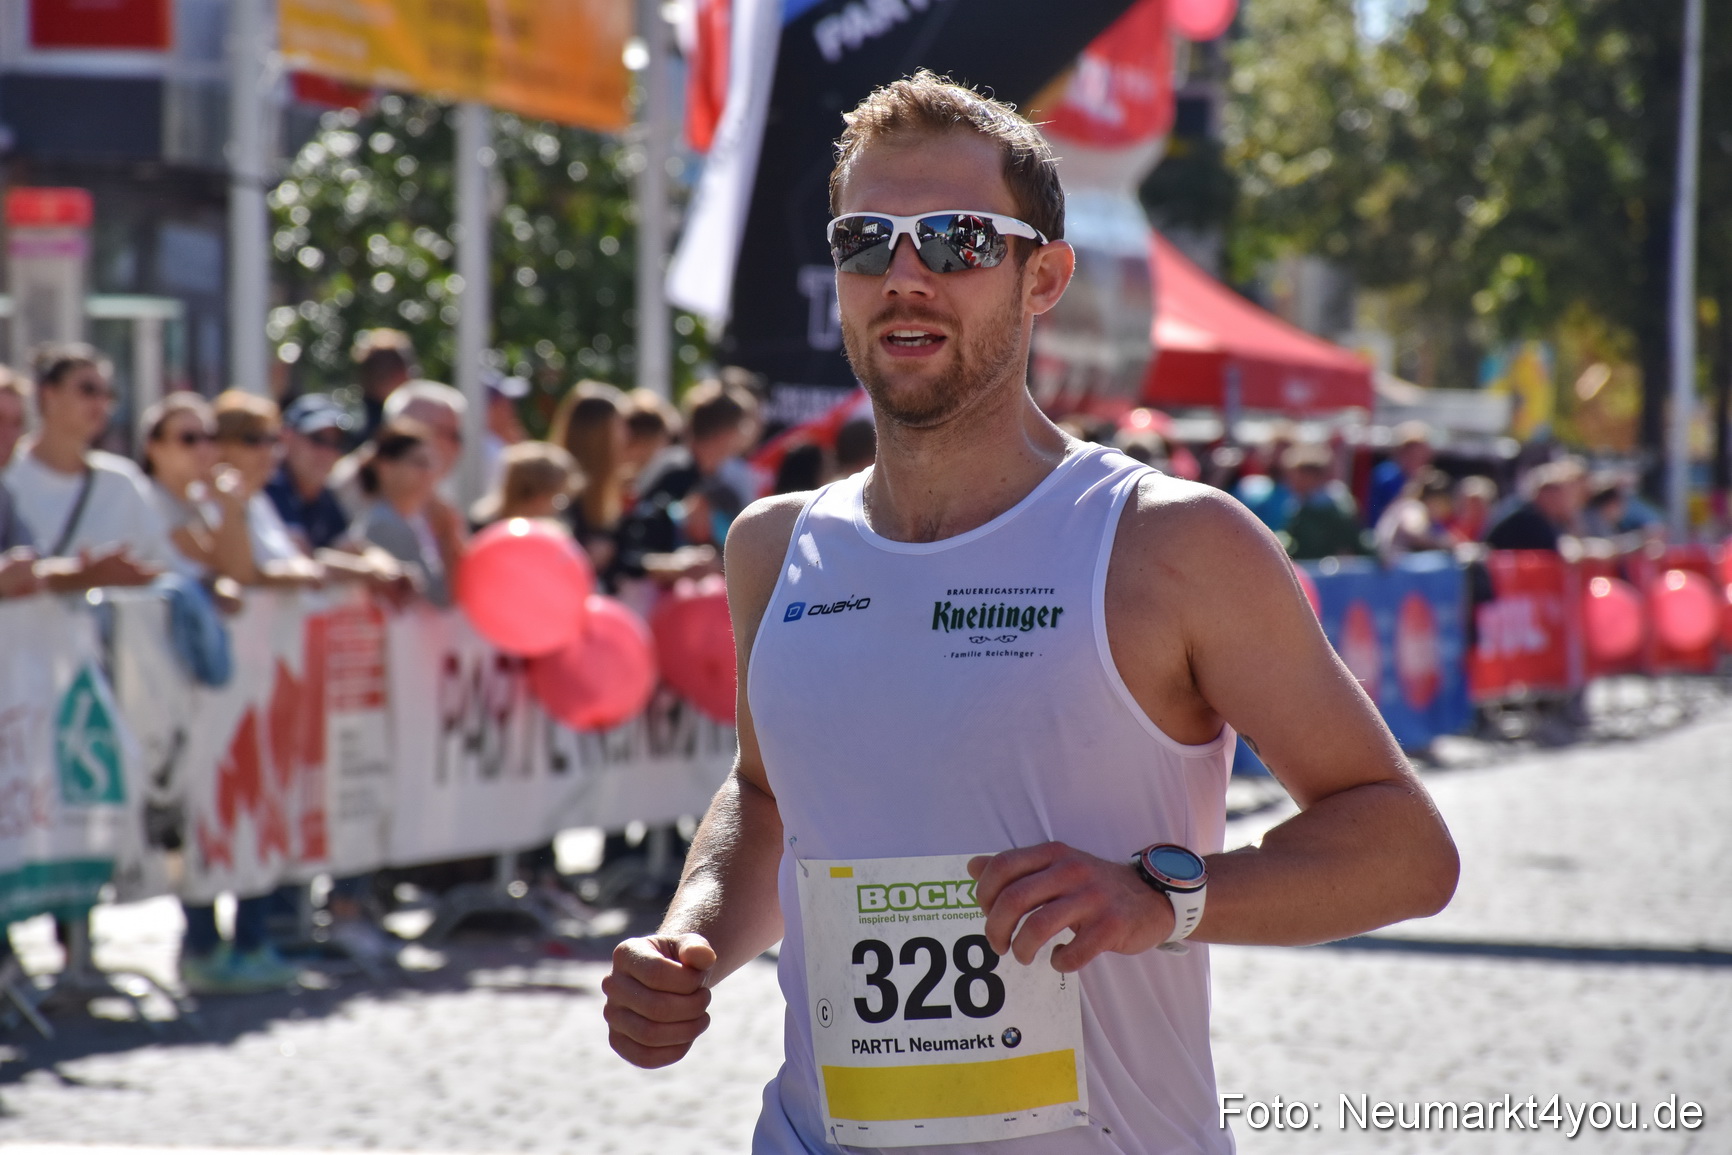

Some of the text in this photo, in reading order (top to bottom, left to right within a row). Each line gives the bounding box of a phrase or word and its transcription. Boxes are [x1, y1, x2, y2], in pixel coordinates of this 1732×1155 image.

[947, 587, 1056, 596] BRAUEREIGASTSTÄTTE
[932, 601, 1064, 633] Kneitinger
[950, 650, 1035, 659] Familie Reichinger
[858, 911, 985, 925] inspired by smart concepts
[851, 934, 1006, 1024] 328
[851, 1038, 905, 1054] PARTL
[909, 1034, 995, 1052] Neumarkt
